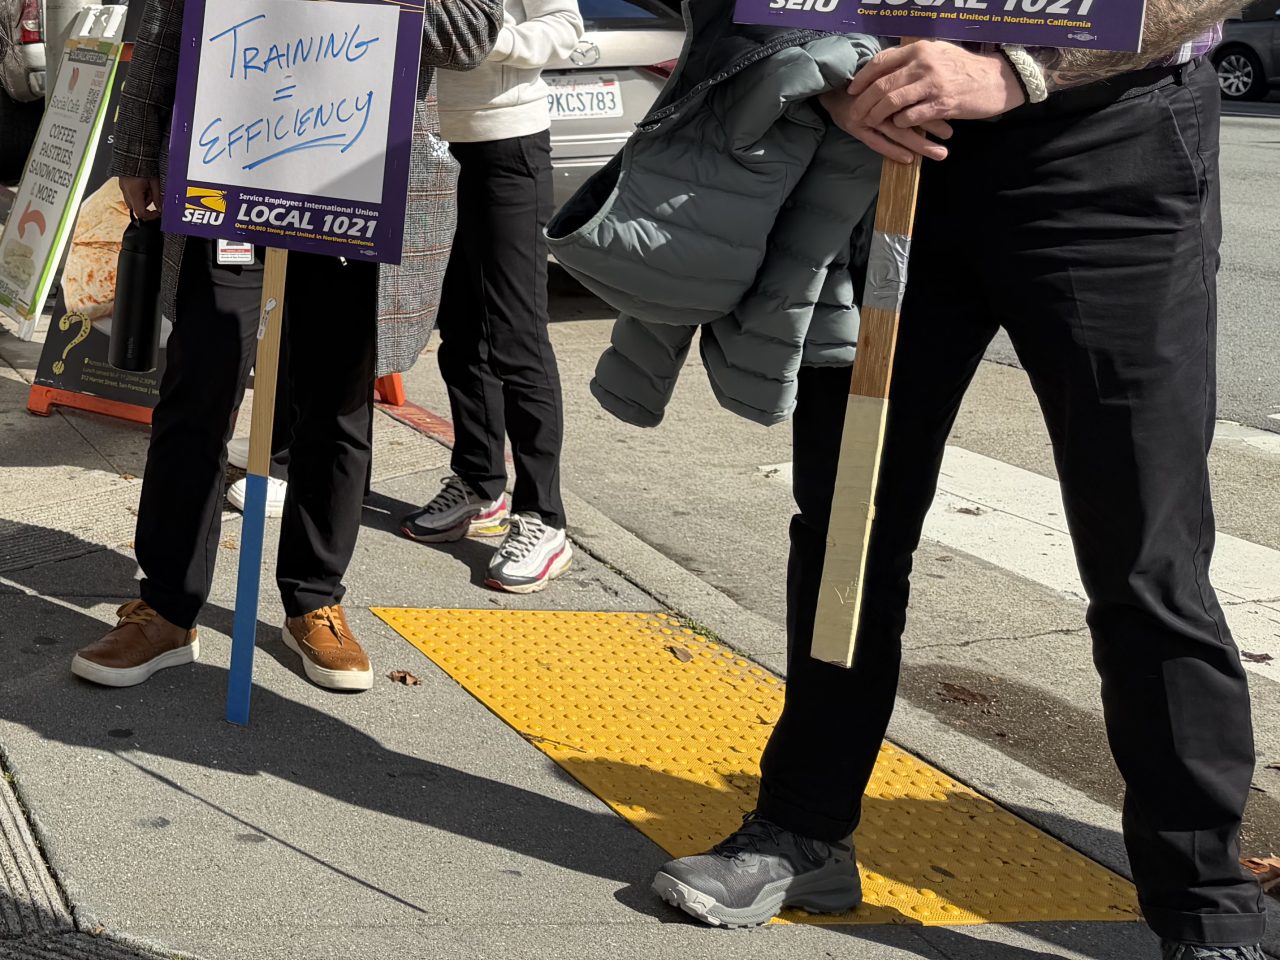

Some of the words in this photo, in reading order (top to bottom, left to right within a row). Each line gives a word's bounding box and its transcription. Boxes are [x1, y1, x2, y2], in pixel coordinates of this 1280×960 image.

[880, 9, 908, 17] 60,000
[910, 10, 937, 18] Strong
[959, 12, 989, 21] United
[992, 14, 1001, 22] in
[1003, 16, 1045, 25] Northern
[1047, 18, 1091, 28] California
[209, 15, 379, 79] TRAINING
[547, 91, 616, 112] 9KCS783
[49, 123, 77, 148] COFFEE,
[199, 91, 373, 164] EFFICIENCY
[39, 141, 73, 169] PASTRIES,
[29, 159, 73, 188] SANDWICHES
[35, 183, 58, 205] MORE
[239, 193, 263, 202] Service
[265, 196, 302, 207] Employees
[305, 201, 353, 214] International
[355, 208, 379, 217] Union
[182, 209, 225, 225] SEIU
[237, 203, 314, 230] LOCAL
[323, 214, 377, 238] 1021
[267, 227, 285, 235] Strong
[323, 235, 347, 243] Northern
[348, 238, 374, 247] California
